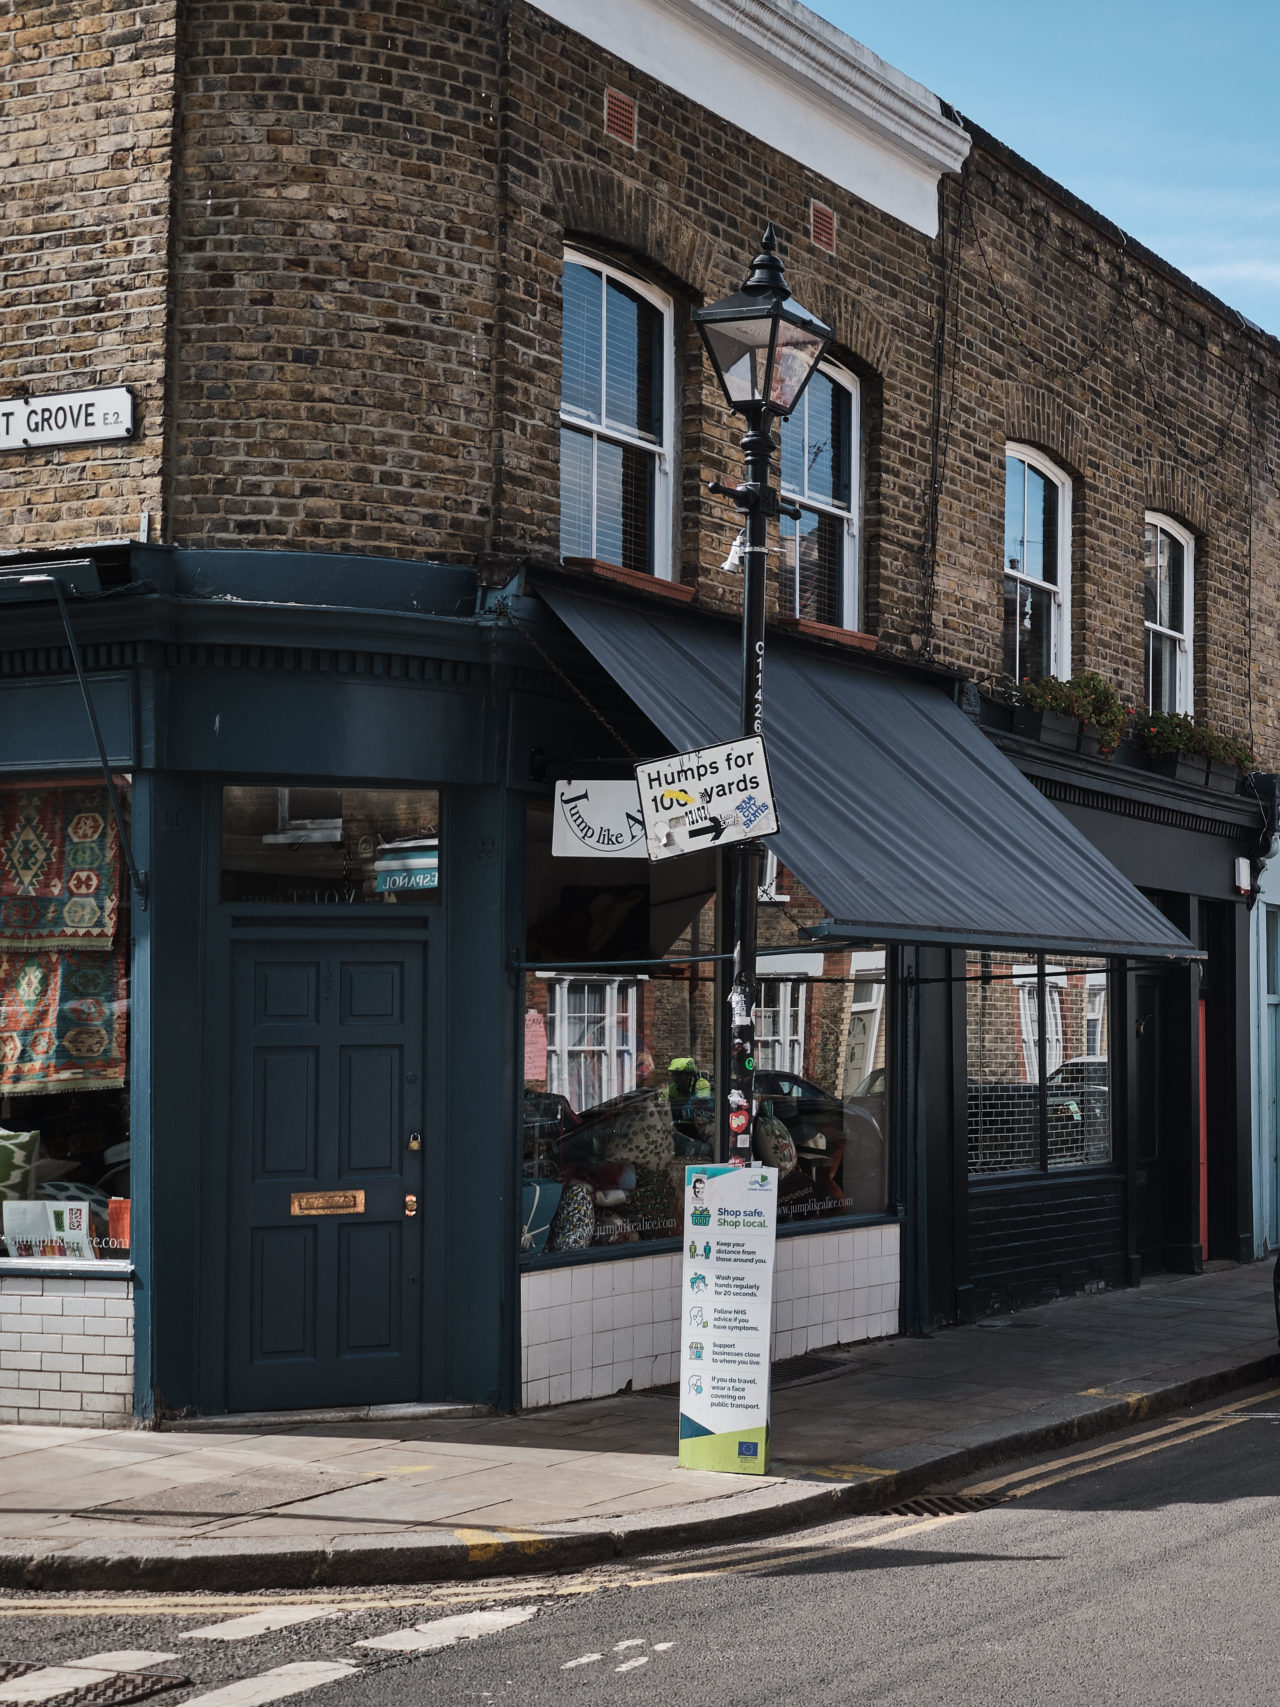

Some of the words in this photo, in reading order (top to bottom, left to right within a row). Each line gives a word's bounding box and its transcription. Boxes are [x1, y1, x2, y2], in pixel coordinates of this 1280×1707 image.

[2, 411, 15, 436] T
[27, 403, 95, 432] GROVE
[647, 760, 719, 789] Humps
[725, 752, 754, 770] for
[652, 789, 689, 813] 100
[704, 774, 760, 803] yards
[560, 788, 595, 841] Jump
[596, 826, 624, 846] like
[717, 1208, 741, 1217] Shop
[743, 1208, 765, 1217] safe.
[717, 1218, 741, 1229] Shop
[742, 1219, 768, 1228] local.
[733, 1283, 760, 1291] regularly
[730, 1402, 760, 1410] transport.
